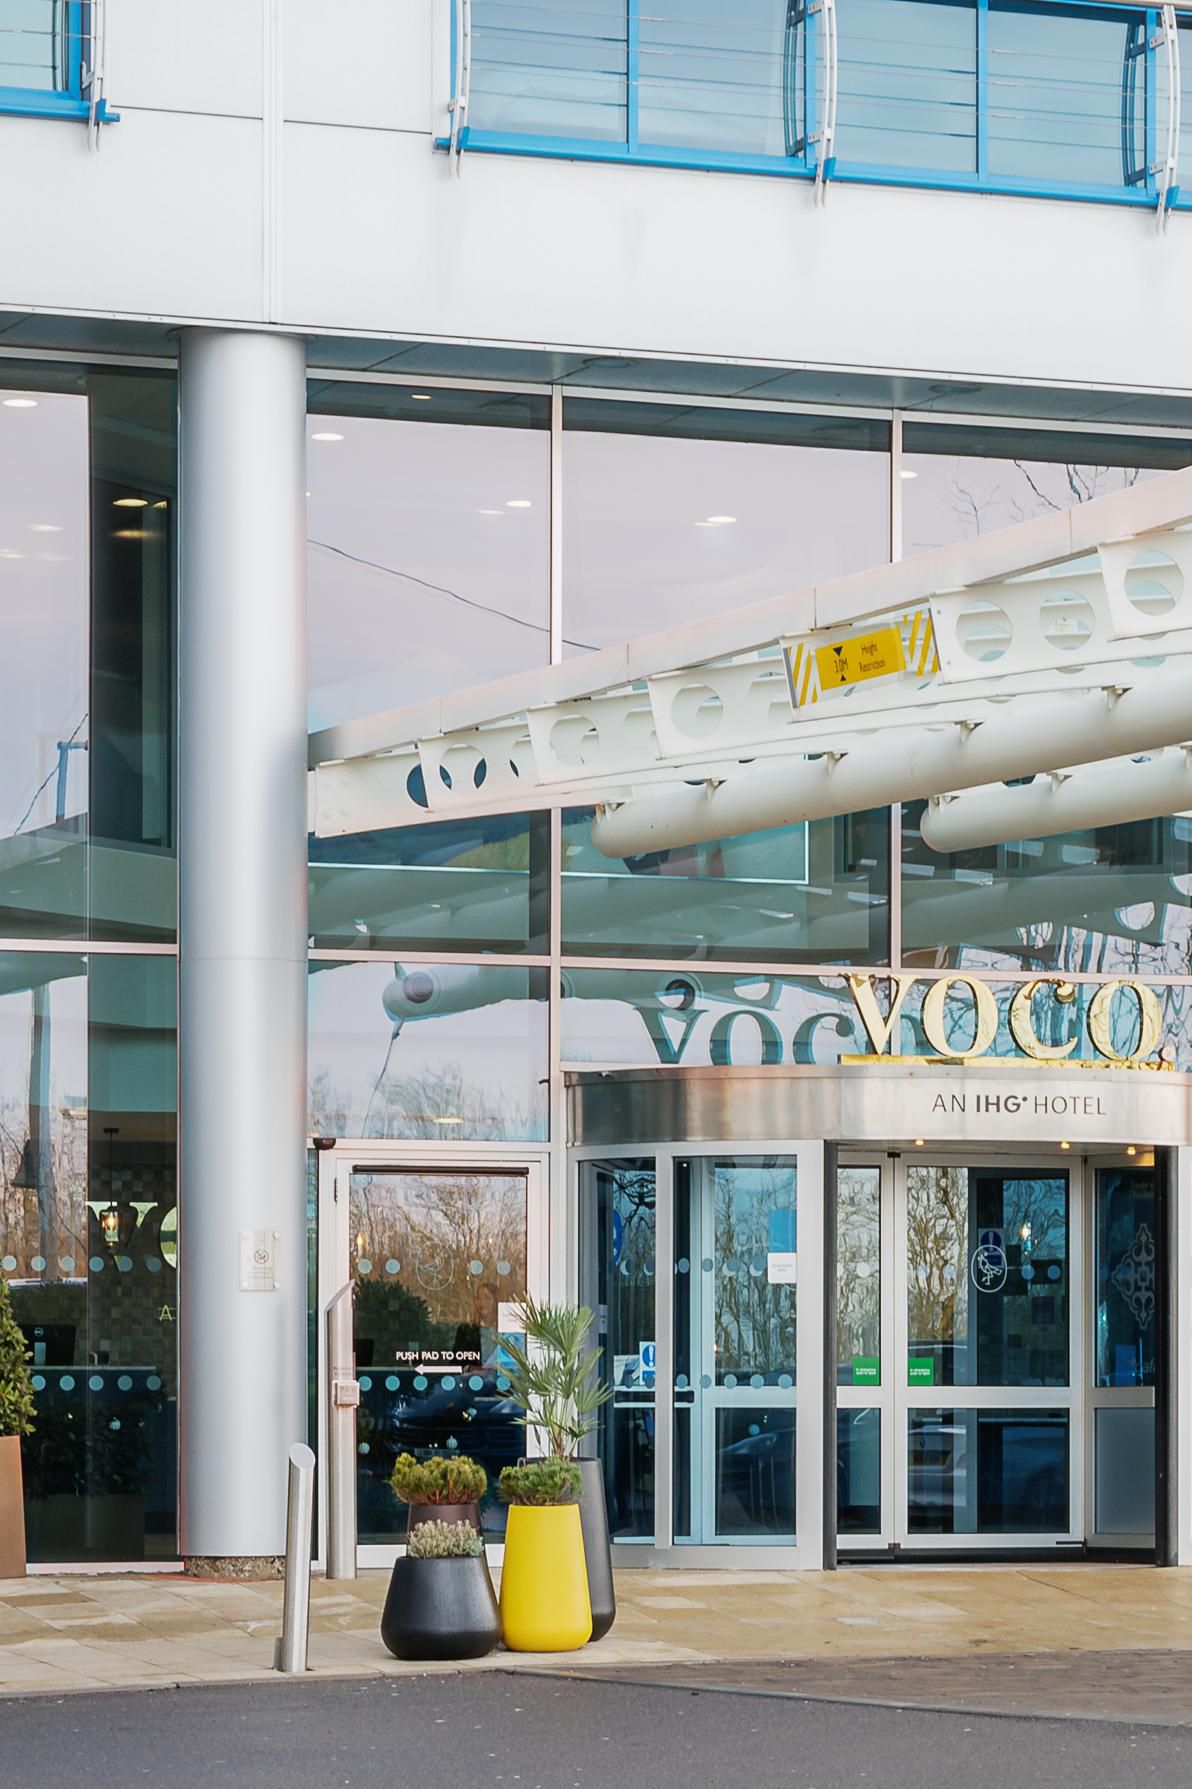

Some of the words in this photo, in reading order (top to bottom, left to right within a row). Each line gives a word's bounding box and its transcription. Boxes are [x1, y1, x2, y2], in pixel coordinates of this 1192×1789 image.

[861, 641, 878, 656] Height
[932, 1093, 966, 1113] AN
[1034, 1095, 1107, 1115] HOTEL
[395, 1351, 419, 1360] PUSH
[421, 1351, 439, 1360] PAD
[441, 1351, 454, 1360] TO
[455, 1351, 480, 1360] OPEN
